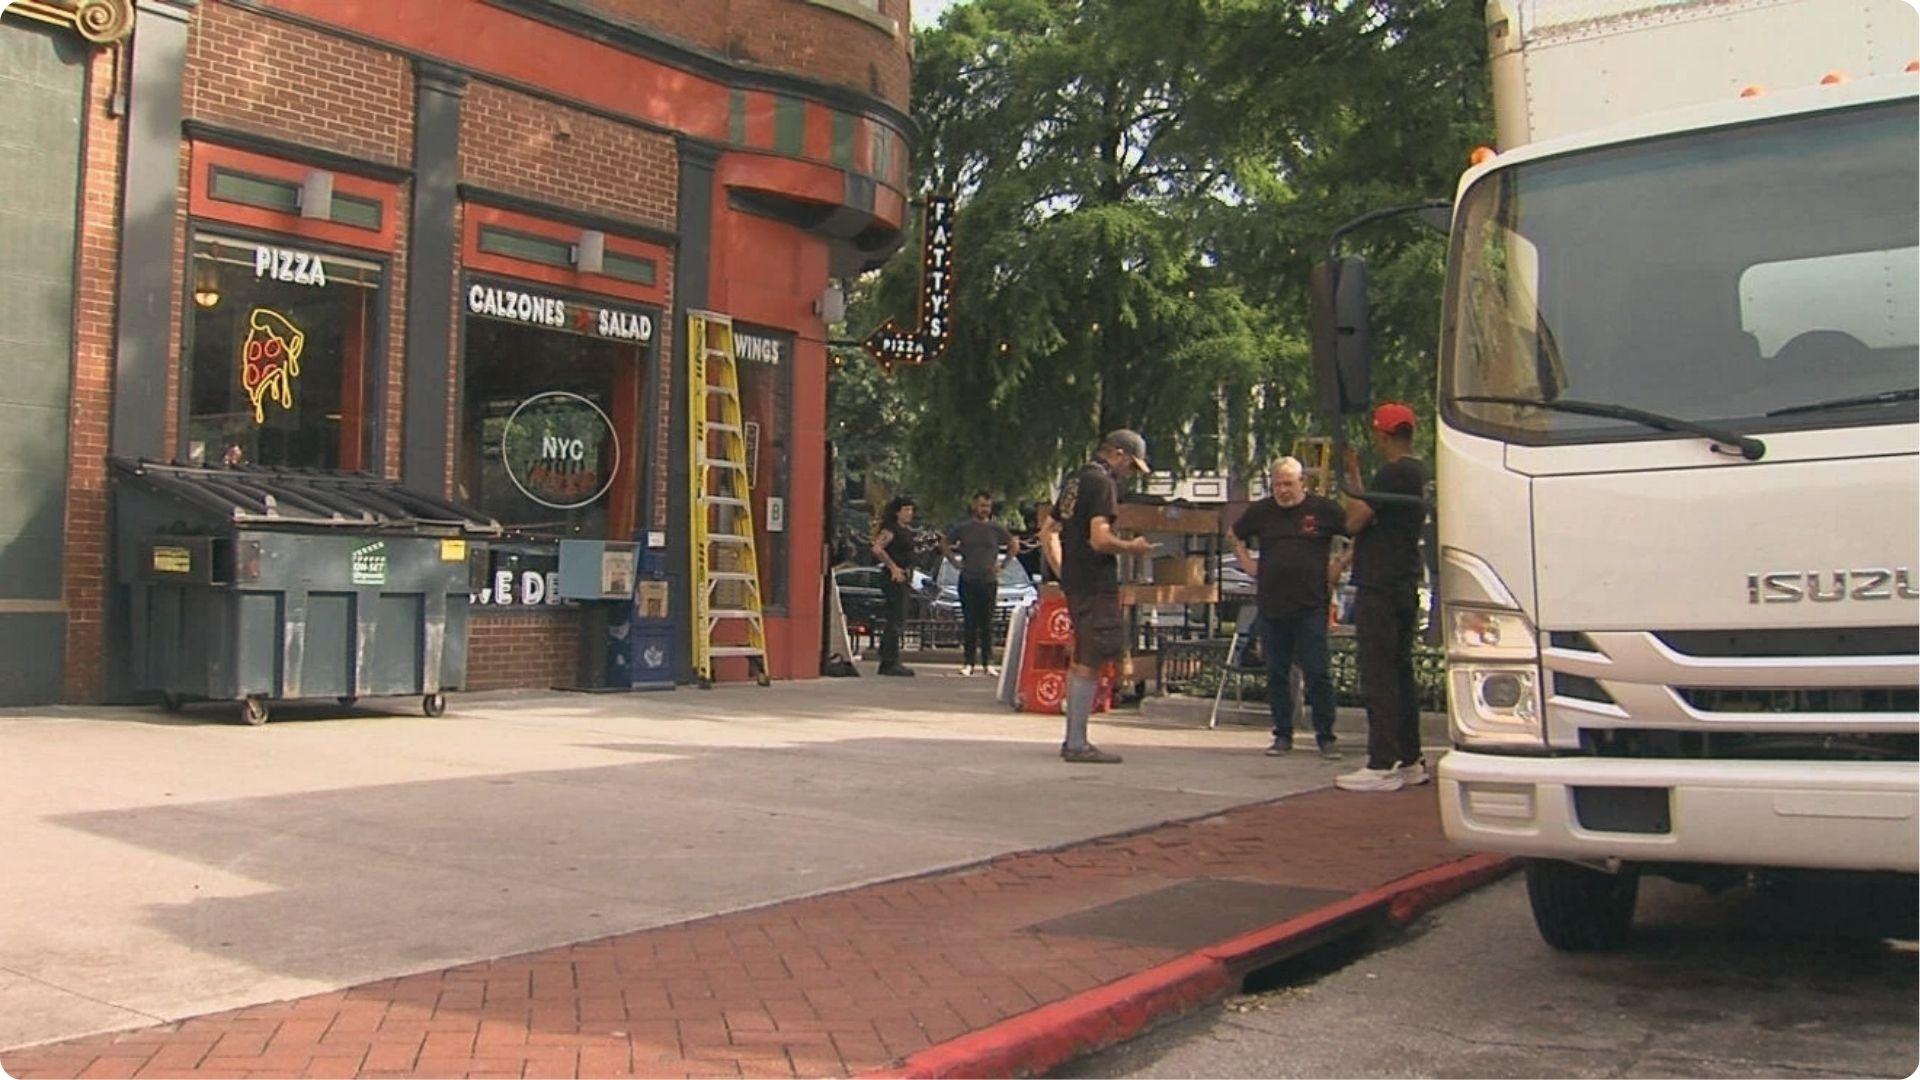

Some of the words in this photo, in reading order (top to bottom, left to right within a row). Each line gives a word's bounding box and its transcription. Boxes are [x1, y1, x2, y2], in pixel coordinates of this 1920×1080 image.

[255, 246, 326, 287] PIZZA
[930, 202, 947, 337] FATTY'S
[468, 284, 565, 327] CALZONES
[598, 309, 652, 341] SALAD
[733, 332, 779, 365] WINGS
[882, 339, 925, 355] PIZZA
[542, 436, 584, 461] NYC
